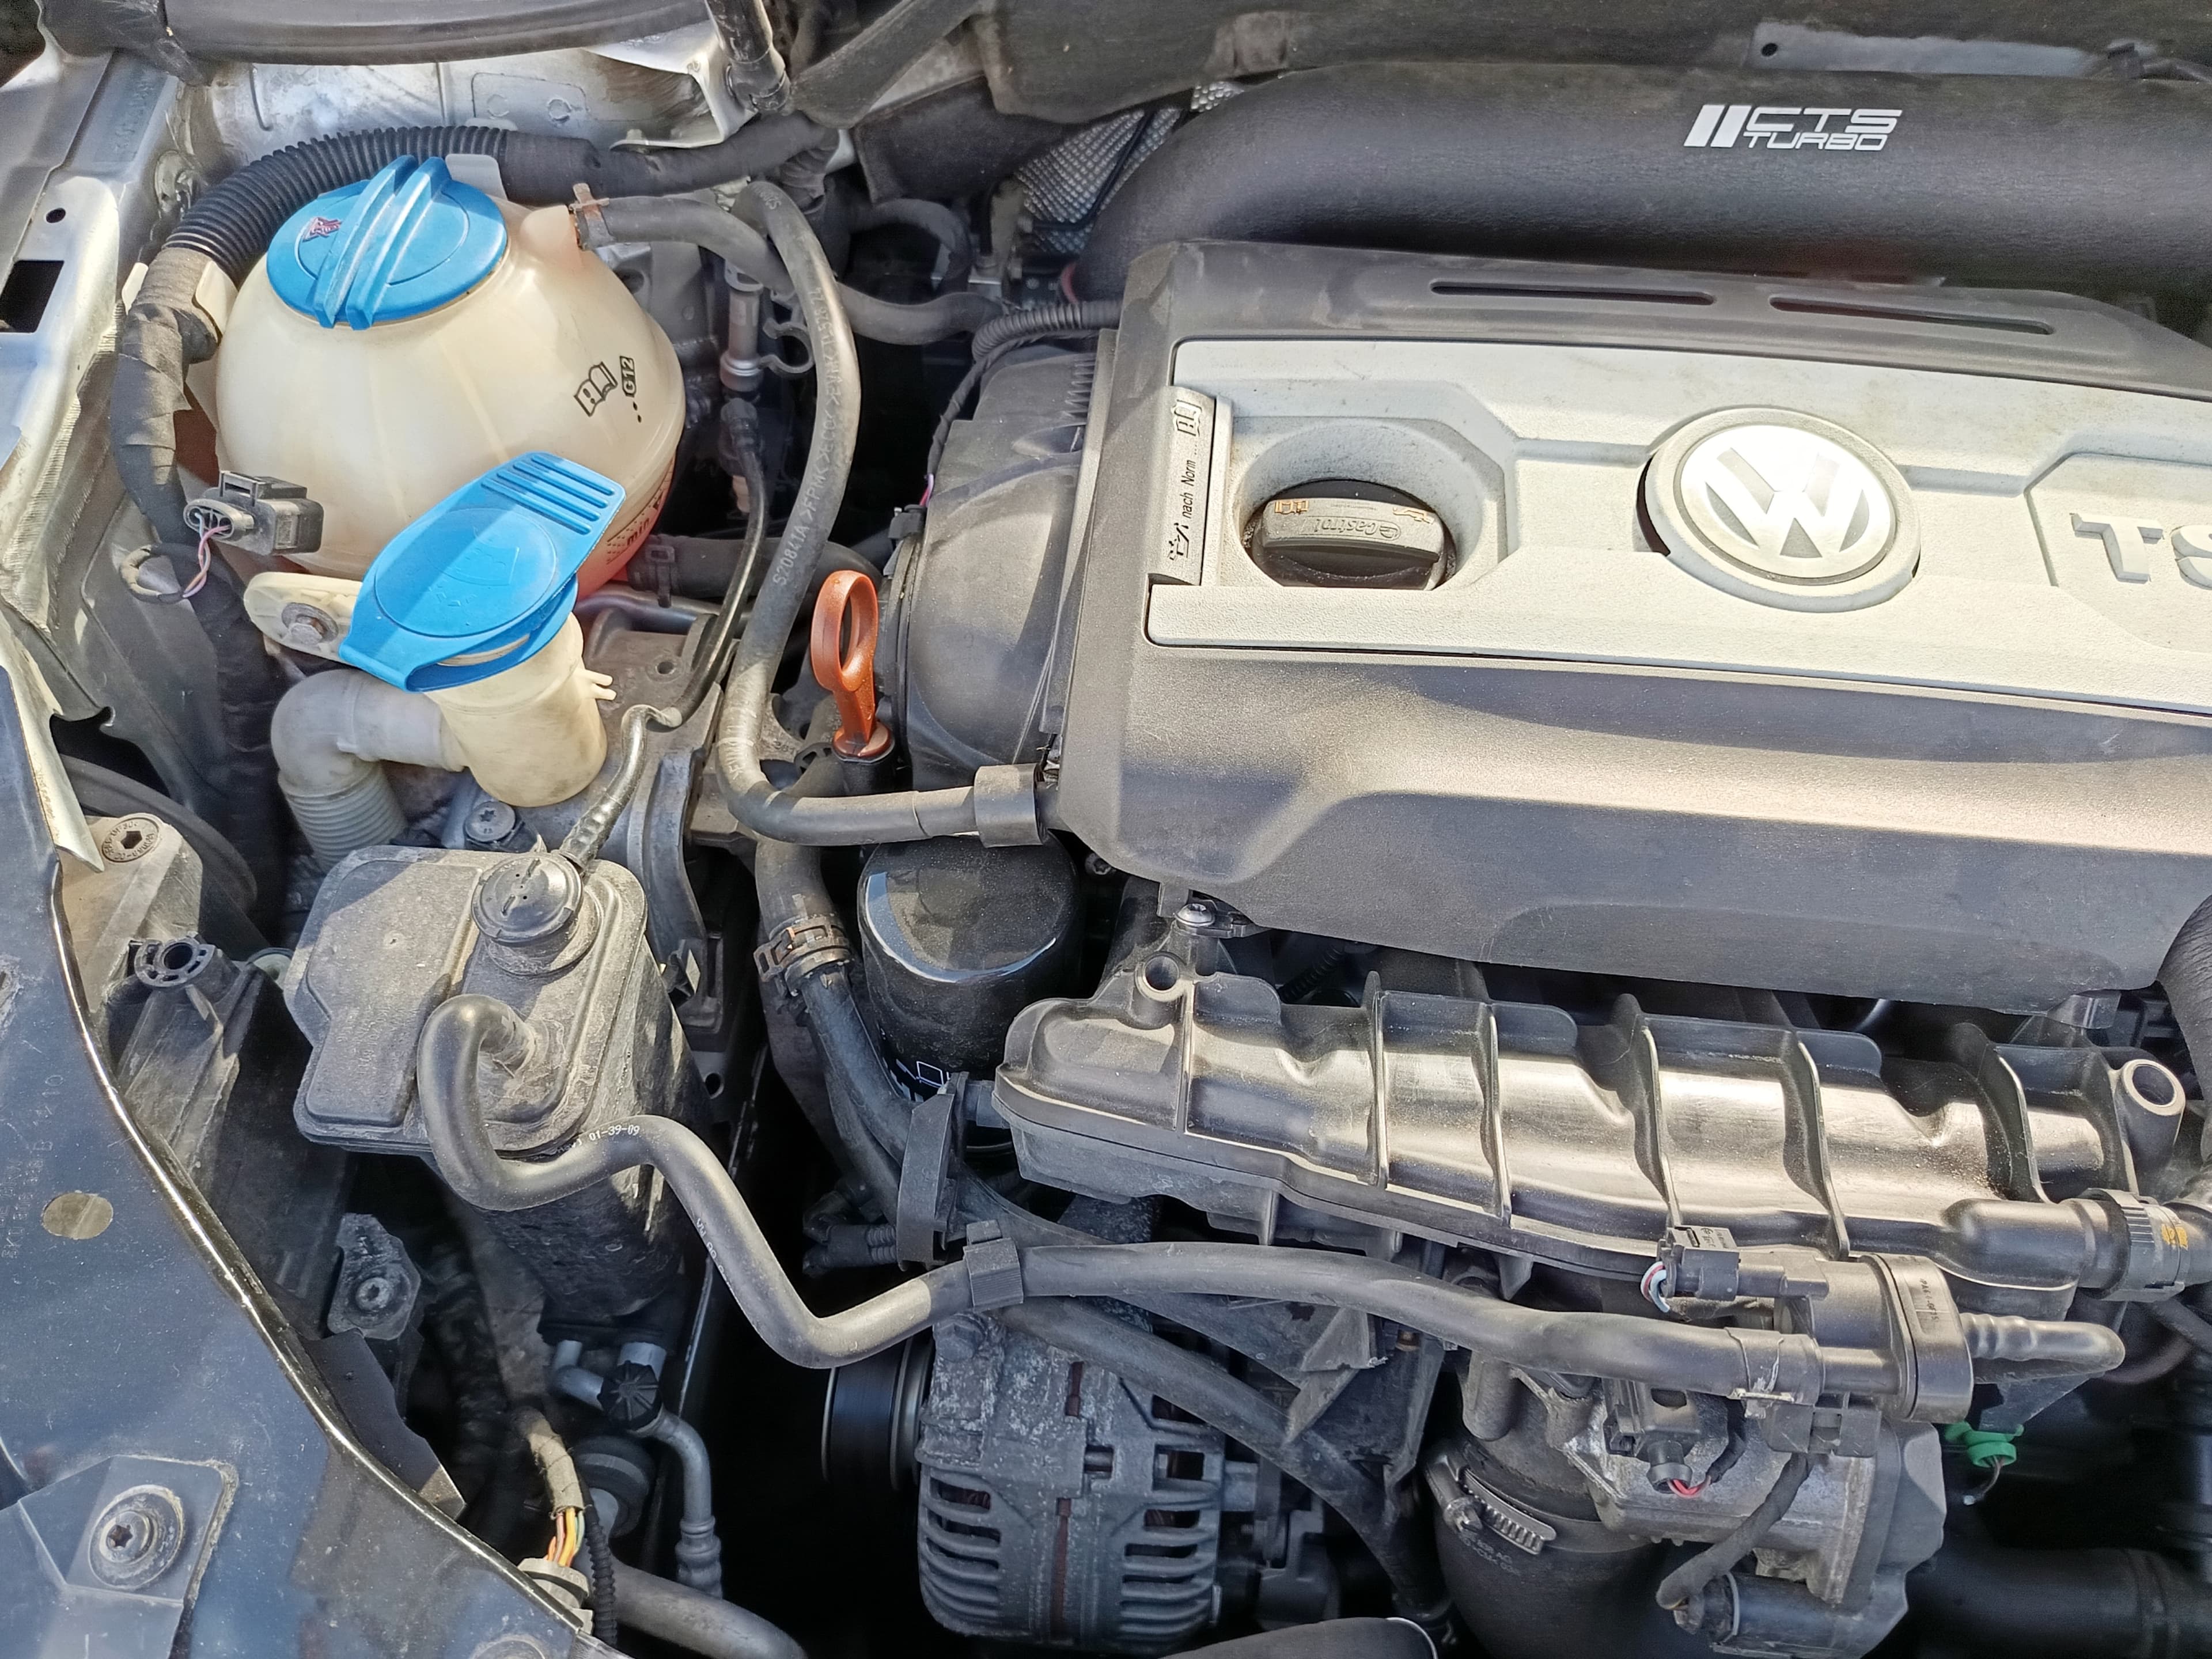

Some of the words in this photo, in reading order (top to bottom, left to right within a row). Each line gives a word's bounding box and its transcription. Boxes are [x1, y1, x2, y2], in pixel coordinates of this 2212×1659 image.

[1745, 107, 1903, 134] CTS
[1743, 131, 1888, 151] TURBO
[622, 357, 636, 395] G12
[1181, 460, 1196, 486] Norm
[1180, 492, 1194, 519] nach
[627, 518, 649, 546] min
[1314, 517, 1378, 536] Castrol
[588, 1124, 640, 1141] 01-39-09
